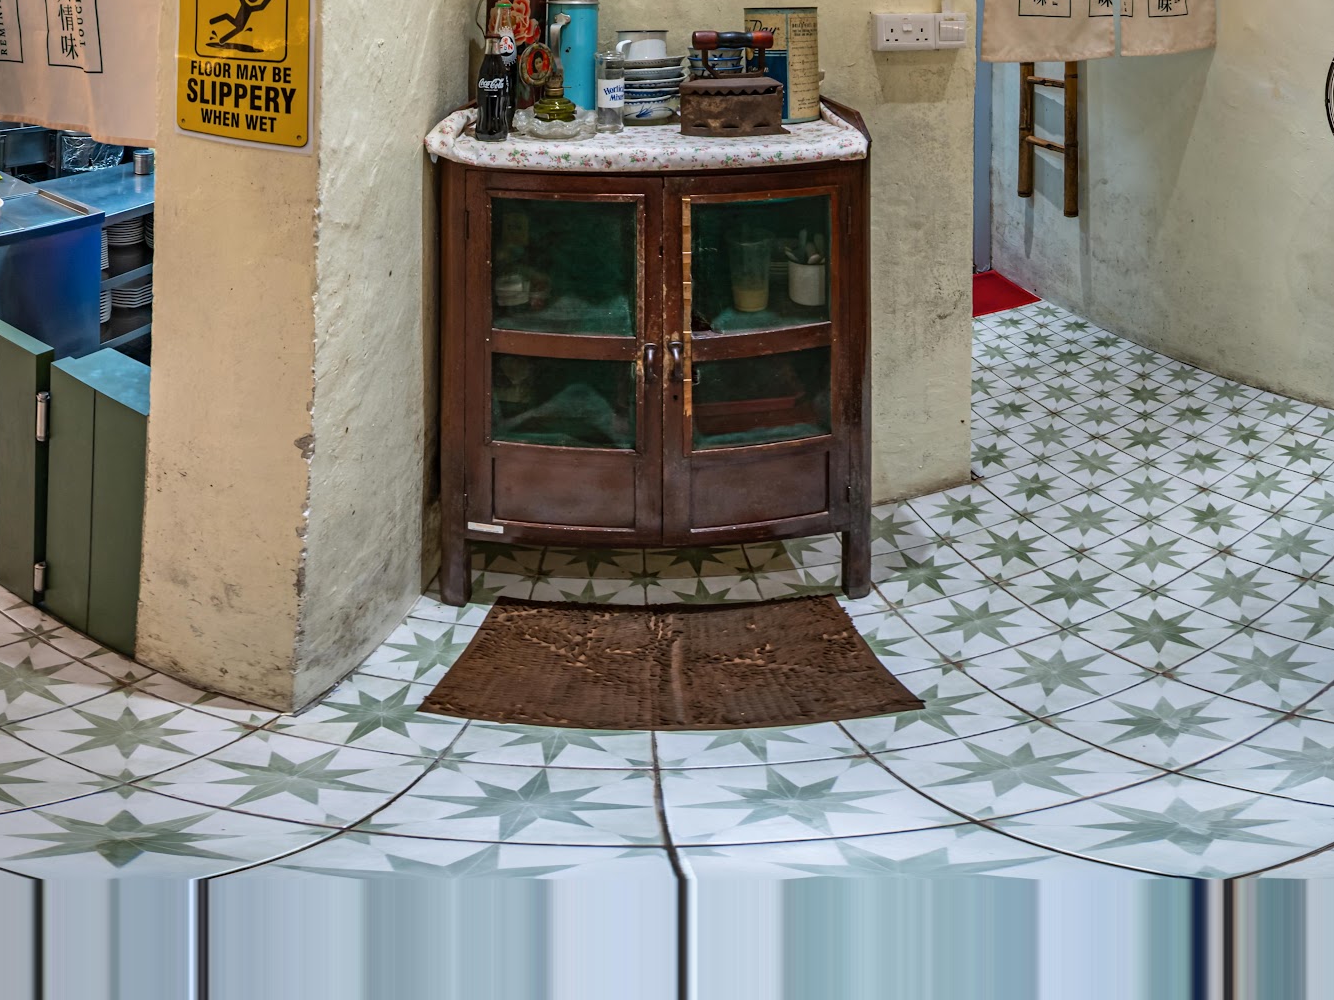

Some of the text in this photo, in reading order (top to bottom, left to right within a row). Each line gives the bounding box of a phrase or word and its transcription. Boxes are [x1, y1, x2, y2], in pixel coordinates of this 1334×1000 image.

[190, 60, 292, 84] FLOOR MAY BE
[186, 77, 297, 115] SLIPPERY
[201, 107, 277, 133] WHEN WET
